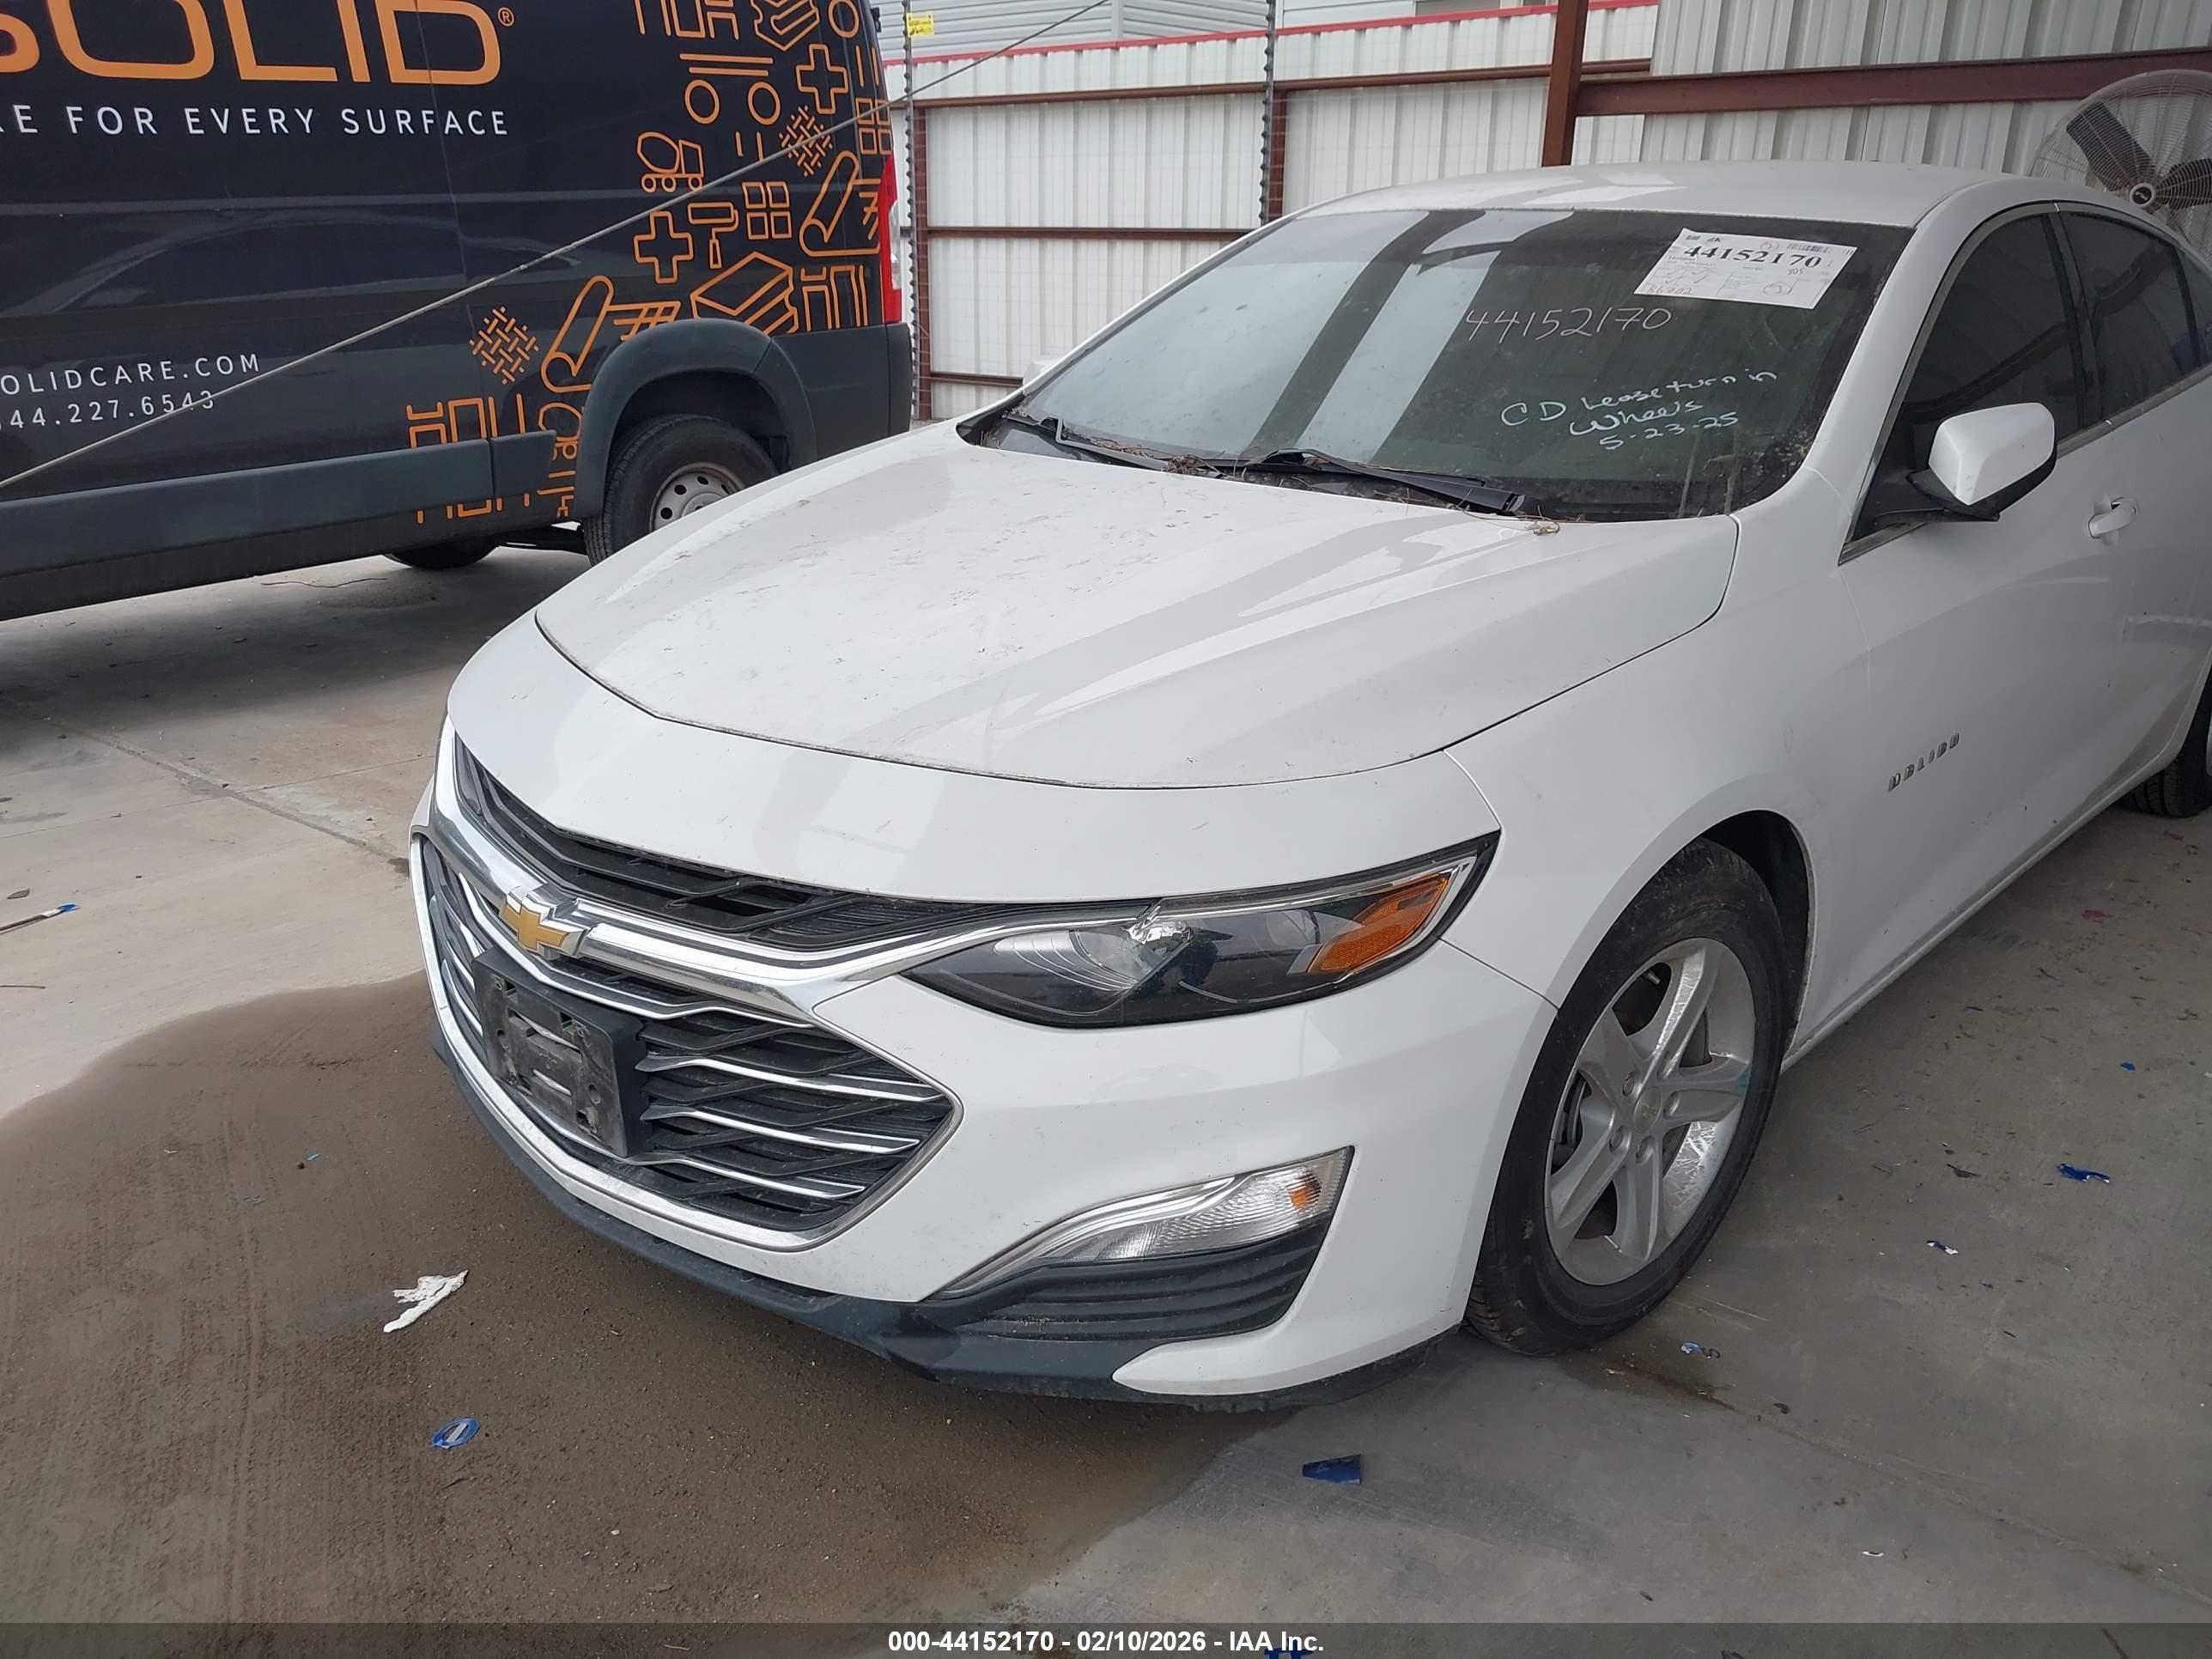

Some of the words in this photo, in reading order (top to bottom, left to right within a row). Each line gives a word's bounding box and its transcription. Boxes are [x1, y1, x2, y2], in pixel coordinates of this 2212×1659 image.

[66, 106, 157, 135] FOR
[185, 107, 313, 134] EVERY
[341, 109, 507, 135] SURFACE
[1684, 246, 1821, 268] 44152170
[1464, 305, 1673, 343] 44152170
[1666, 375, 1736, 392] turn
[1744, 368, 1778, 382] in
[1599, 411, 1739, 450] 5-23-25
[1887, 732, 1960, 792] MALIBU
